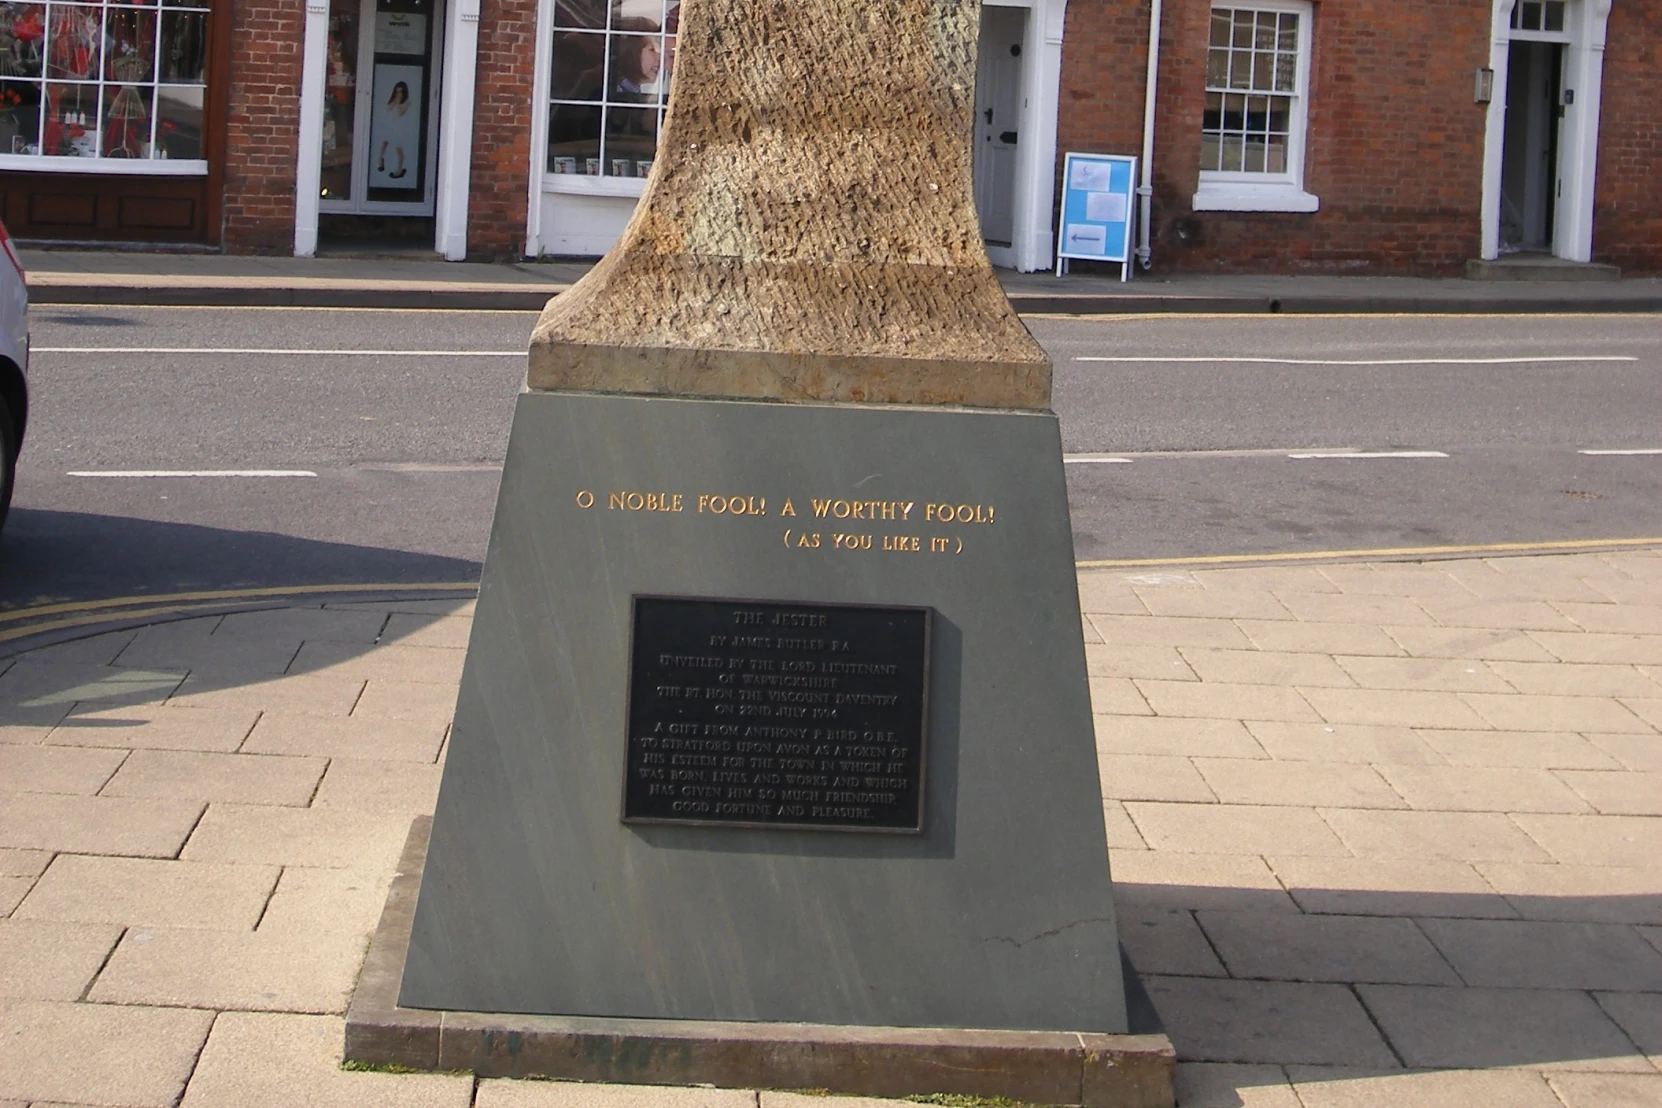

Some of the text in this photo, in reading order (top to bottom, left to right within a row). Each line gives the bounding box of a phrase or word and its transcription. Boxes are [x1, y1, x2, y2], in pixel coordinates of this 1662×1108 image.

[576, 490, 997, 524] O NOBLE FOOL! A WORTHY FOOL!
[832, 533, 873, 550] YOU
[882, 535, 920, 552] LIKE
[734, 612, 828, 627] THE JESTER
[710, 636, 726, 646] BY
[732, 636, 771, 648] JAMES
[777, 638, 824, 650] BUTLER
[660, 655, 897, 676] UNVEILED BY THE LORD LIEUTENANT
[719, 674, 838, 688] OF WARWICKSHIRE
[657, 686, 681, 697] THE
[738, 690, 764, 700] THE
[768, 690, 828, 704] VISCOUNT
[835, 694, 898, 706] DAVENTRY
[715, 704, 734, 715] ON
[740, 705, 772, 717] 22ND
[776, 707, 806, 718] JULY
[654, 722, 663, 733] A
[669, 723, 698, 734] GIFT
[704, 724, 738, 736] FROM
[744, 726, 808, 738] ANTHONY
[640, 738, 908, 758] TO STRATFORD UPON AVON AS A TOKEN OF
[643, 753, 904, 774] HIS ESTEEM FOR THE TOWN IN WHICH HE
[639, 768, 664, 780] WAS
[712, 771, 746, 783] LIVES
[753, 773, 780, 784] AND
[786, 774, 828, 786] WORKS
[834, 776, 859, 788] AND
[865, 776, 908, 790] WHICH
[650, 784, 678, 796] HAS
[682, 786, 722, 798] GIVEN
[727, 787, 752, 799] HIM
[758, 788, 776, 800] SO
[782, 789, 819, 802] MUCH
[672, 801, 709, 812] GOOD
[716, 802, 772, 816] FORTUNE
[777, 805, 804, 816] AND
